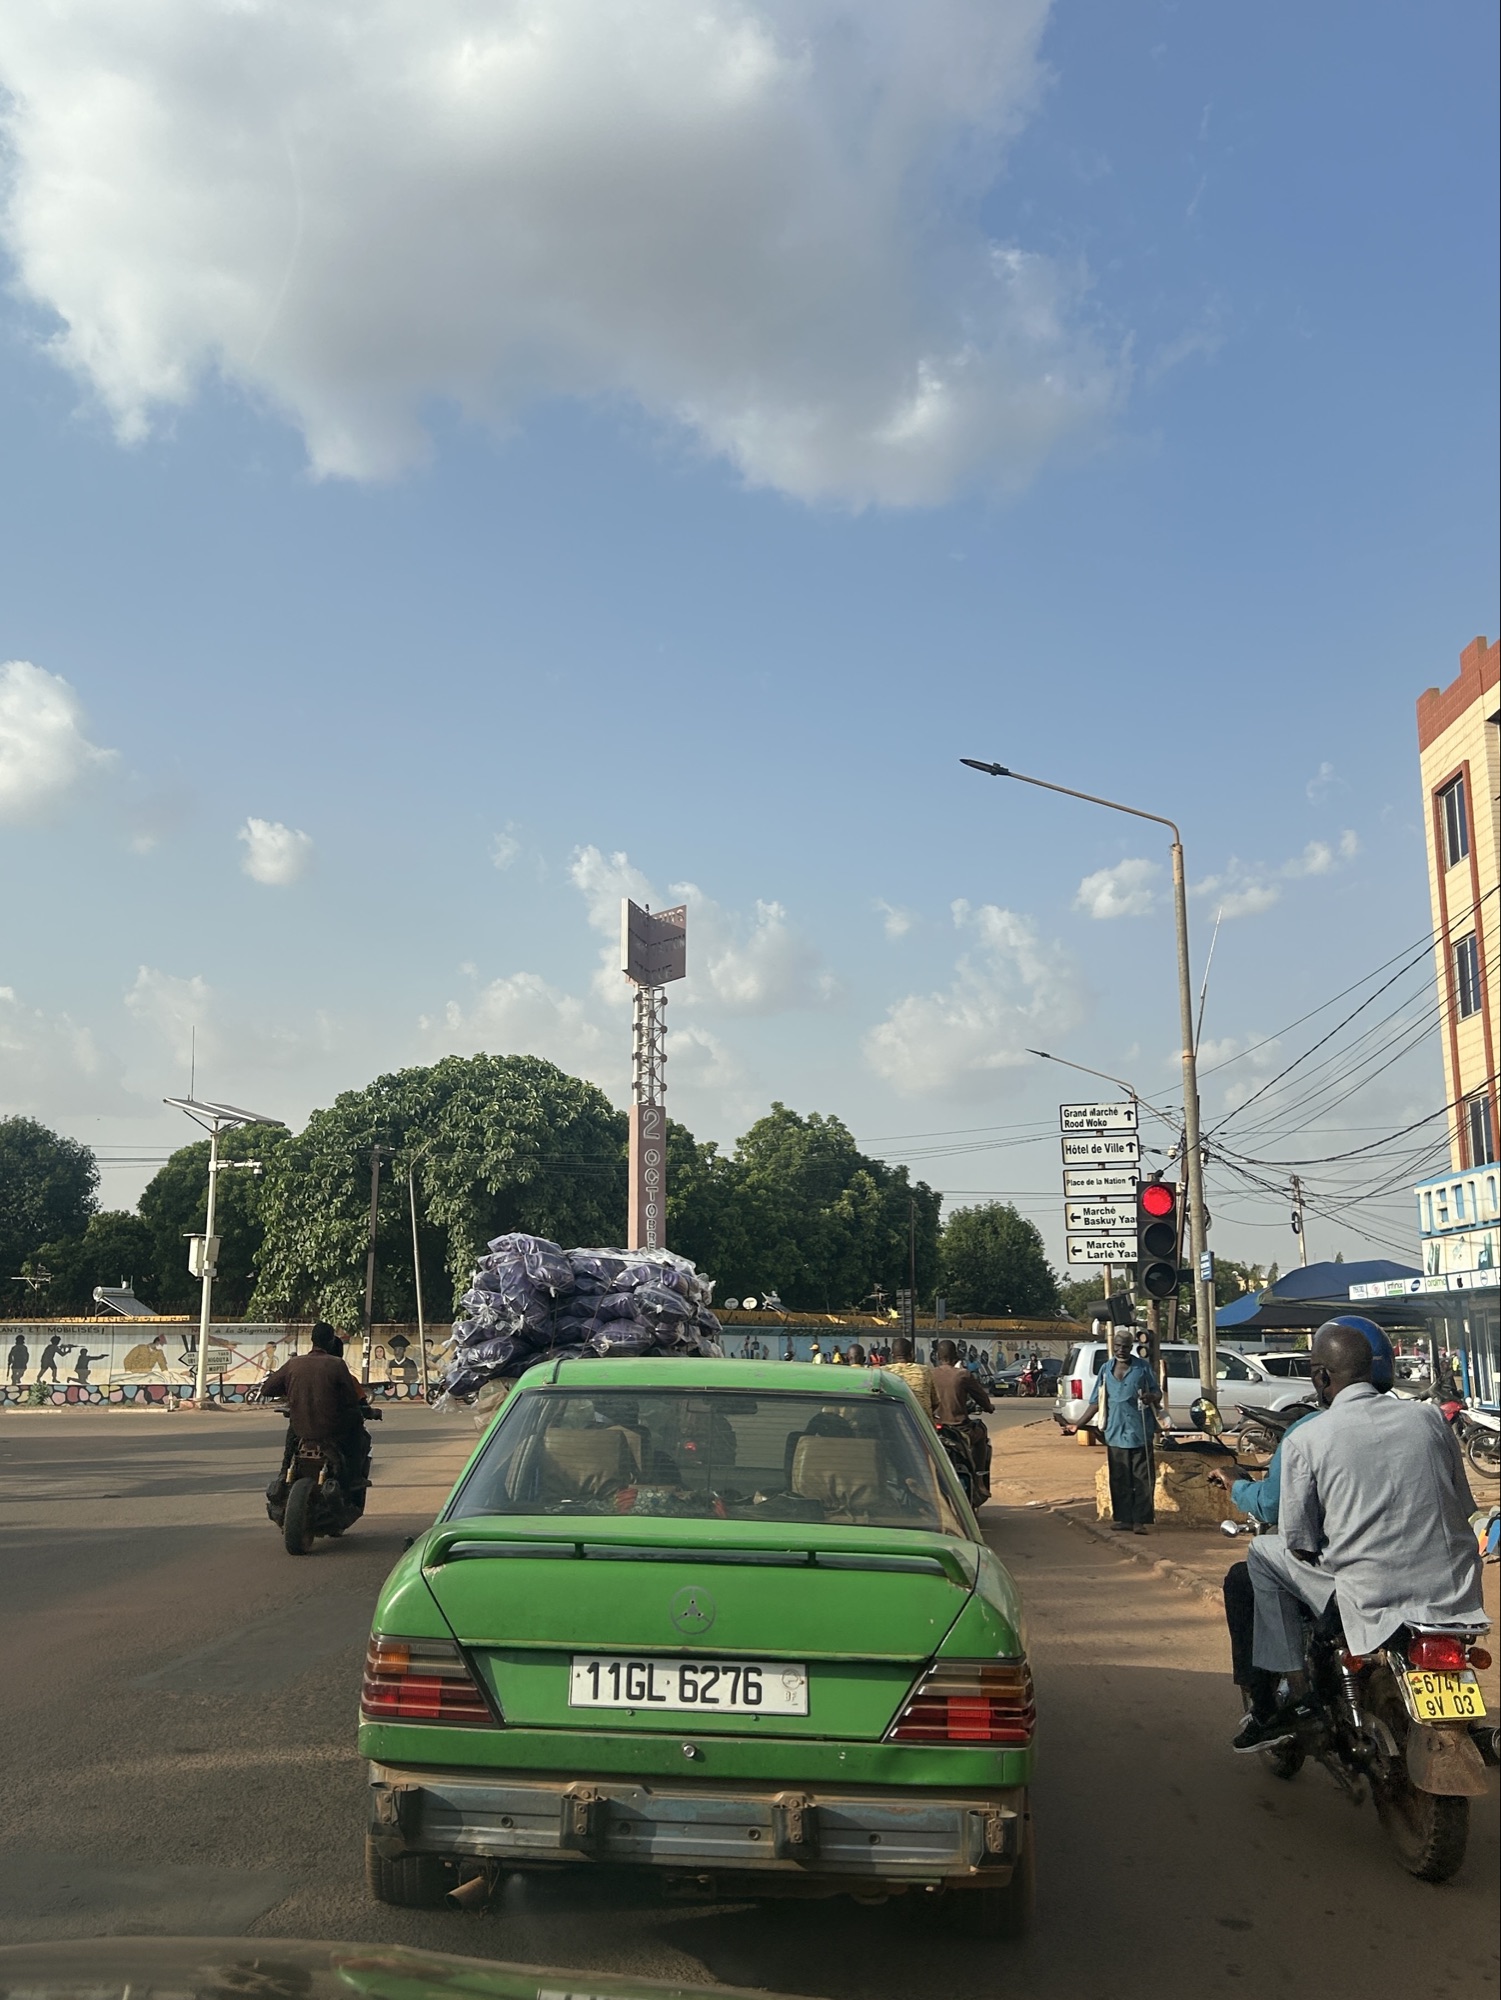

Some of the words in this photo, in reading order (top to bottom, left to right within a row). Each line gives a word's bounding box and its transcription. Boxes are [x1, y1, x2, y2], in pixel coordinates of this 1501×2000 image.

[1064, 1109, 1087, 1117] Grand
[1090, 1107, 1118, 1116] Marché
[642, 1108, 660, 1140] 2
[1064, 1119, 1084, 1128] Rood
[1086, 1118, 1107, 1127] Woko
[1065, 1144, 1088, 1154] Hôtel
[1091, 1144, 1102, 1153] de
[1104, 1143, 1124, 1153] Ville
[1083, 1206, 1116, 1215] Marché
[1084, 1217, 1116, 1226] Baskuy
[1086, 1240, 1126, 1249] Marché
[1087, 1250, 1114, 1259] Larlé
[586, 1661, 666, 1701] 11GL
[678, 1664, 762, 1705] 6276
[1423, 1672, 1461, 1694] 6747
[1453, 1695, 1475, 1715] 03
